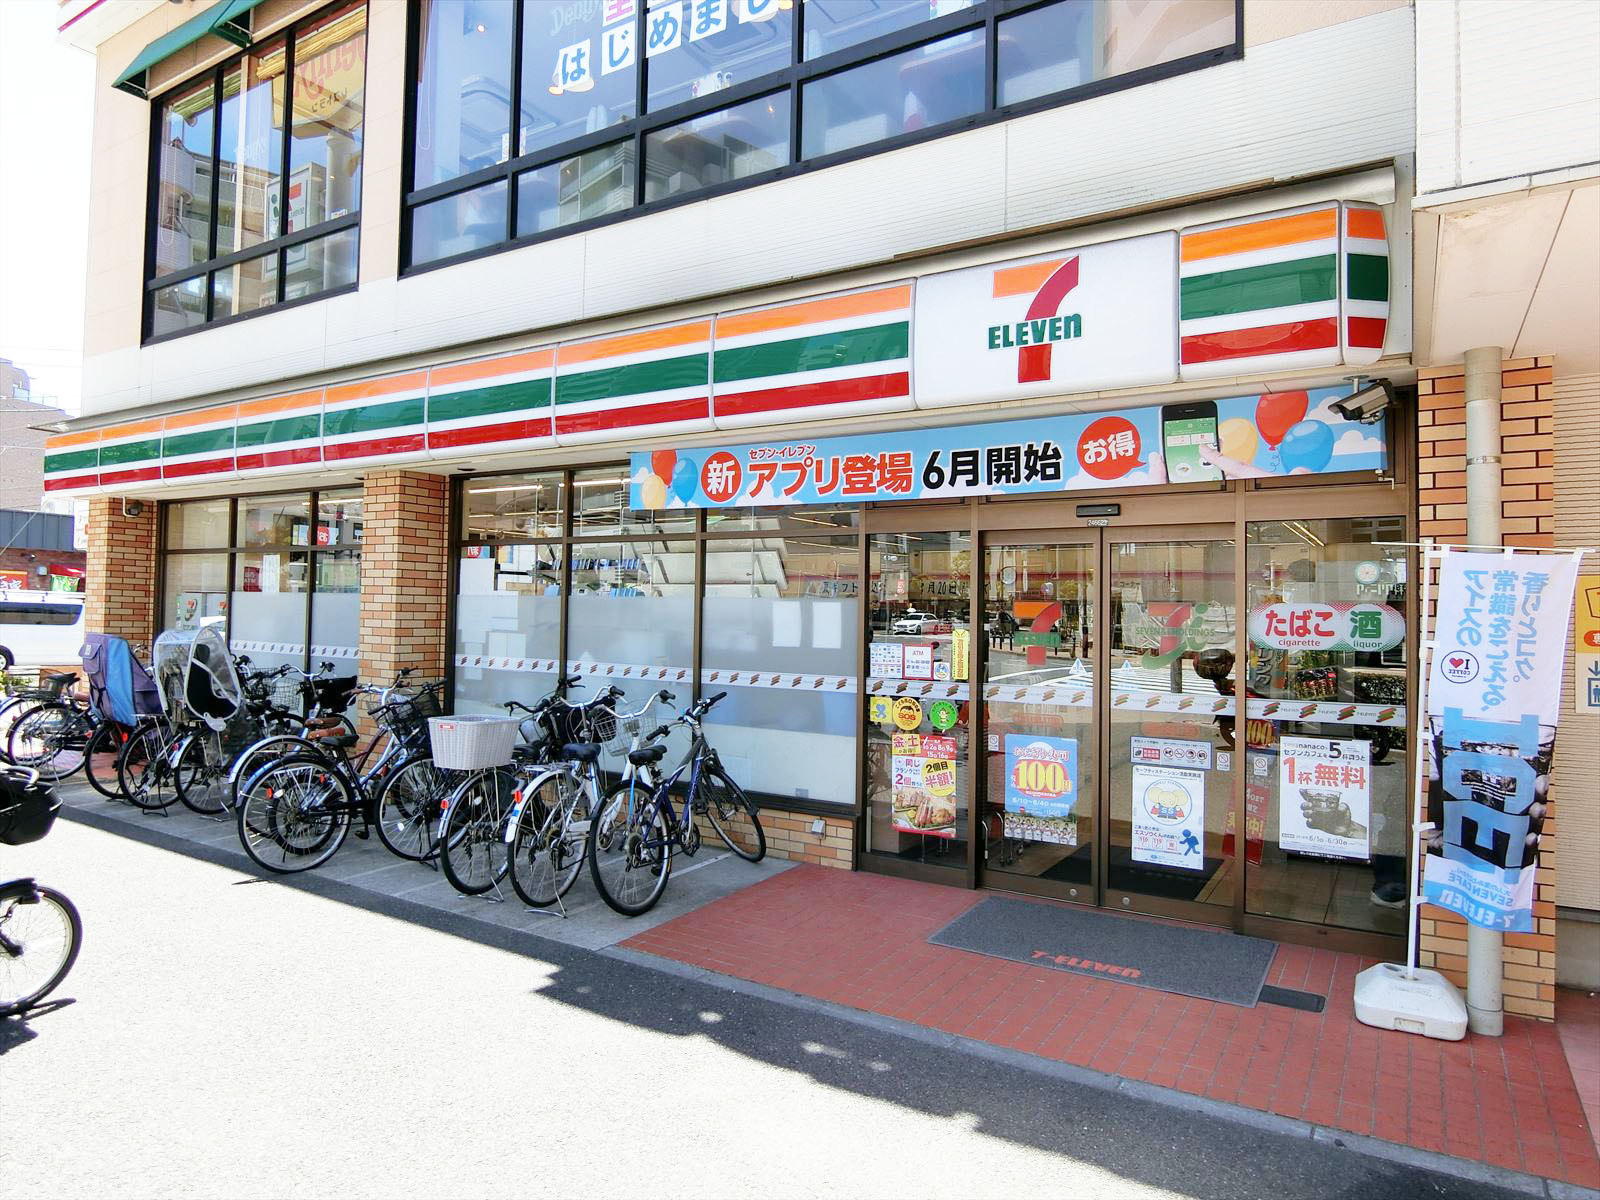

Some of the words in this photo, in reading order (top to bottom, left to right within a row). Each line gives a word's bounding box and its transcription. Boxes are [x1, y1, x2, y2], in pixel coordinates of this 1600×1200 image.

[993, 255, 1080, 383] 7
[749, 445, 816, 460] セブン・イレブン
[1083, 430, 1136, 464] お得
[707, 459, 736, 495] 新
[749, 452, 913, 497] アプリ登場
[922, 442, 1062, 490] 6月開始
[1265, 609, 1335, 638] たばこ
[1350, 610, 1382, 639] 酒
[1278, 639, 1321, 648] cigarette
[1353, 639, 1383, 648] liquor
[898, 712, 916, 721] SOS
[926, 761, 949, 774] 2個目
[1283, 756, 1366, 790] 1杯無料
